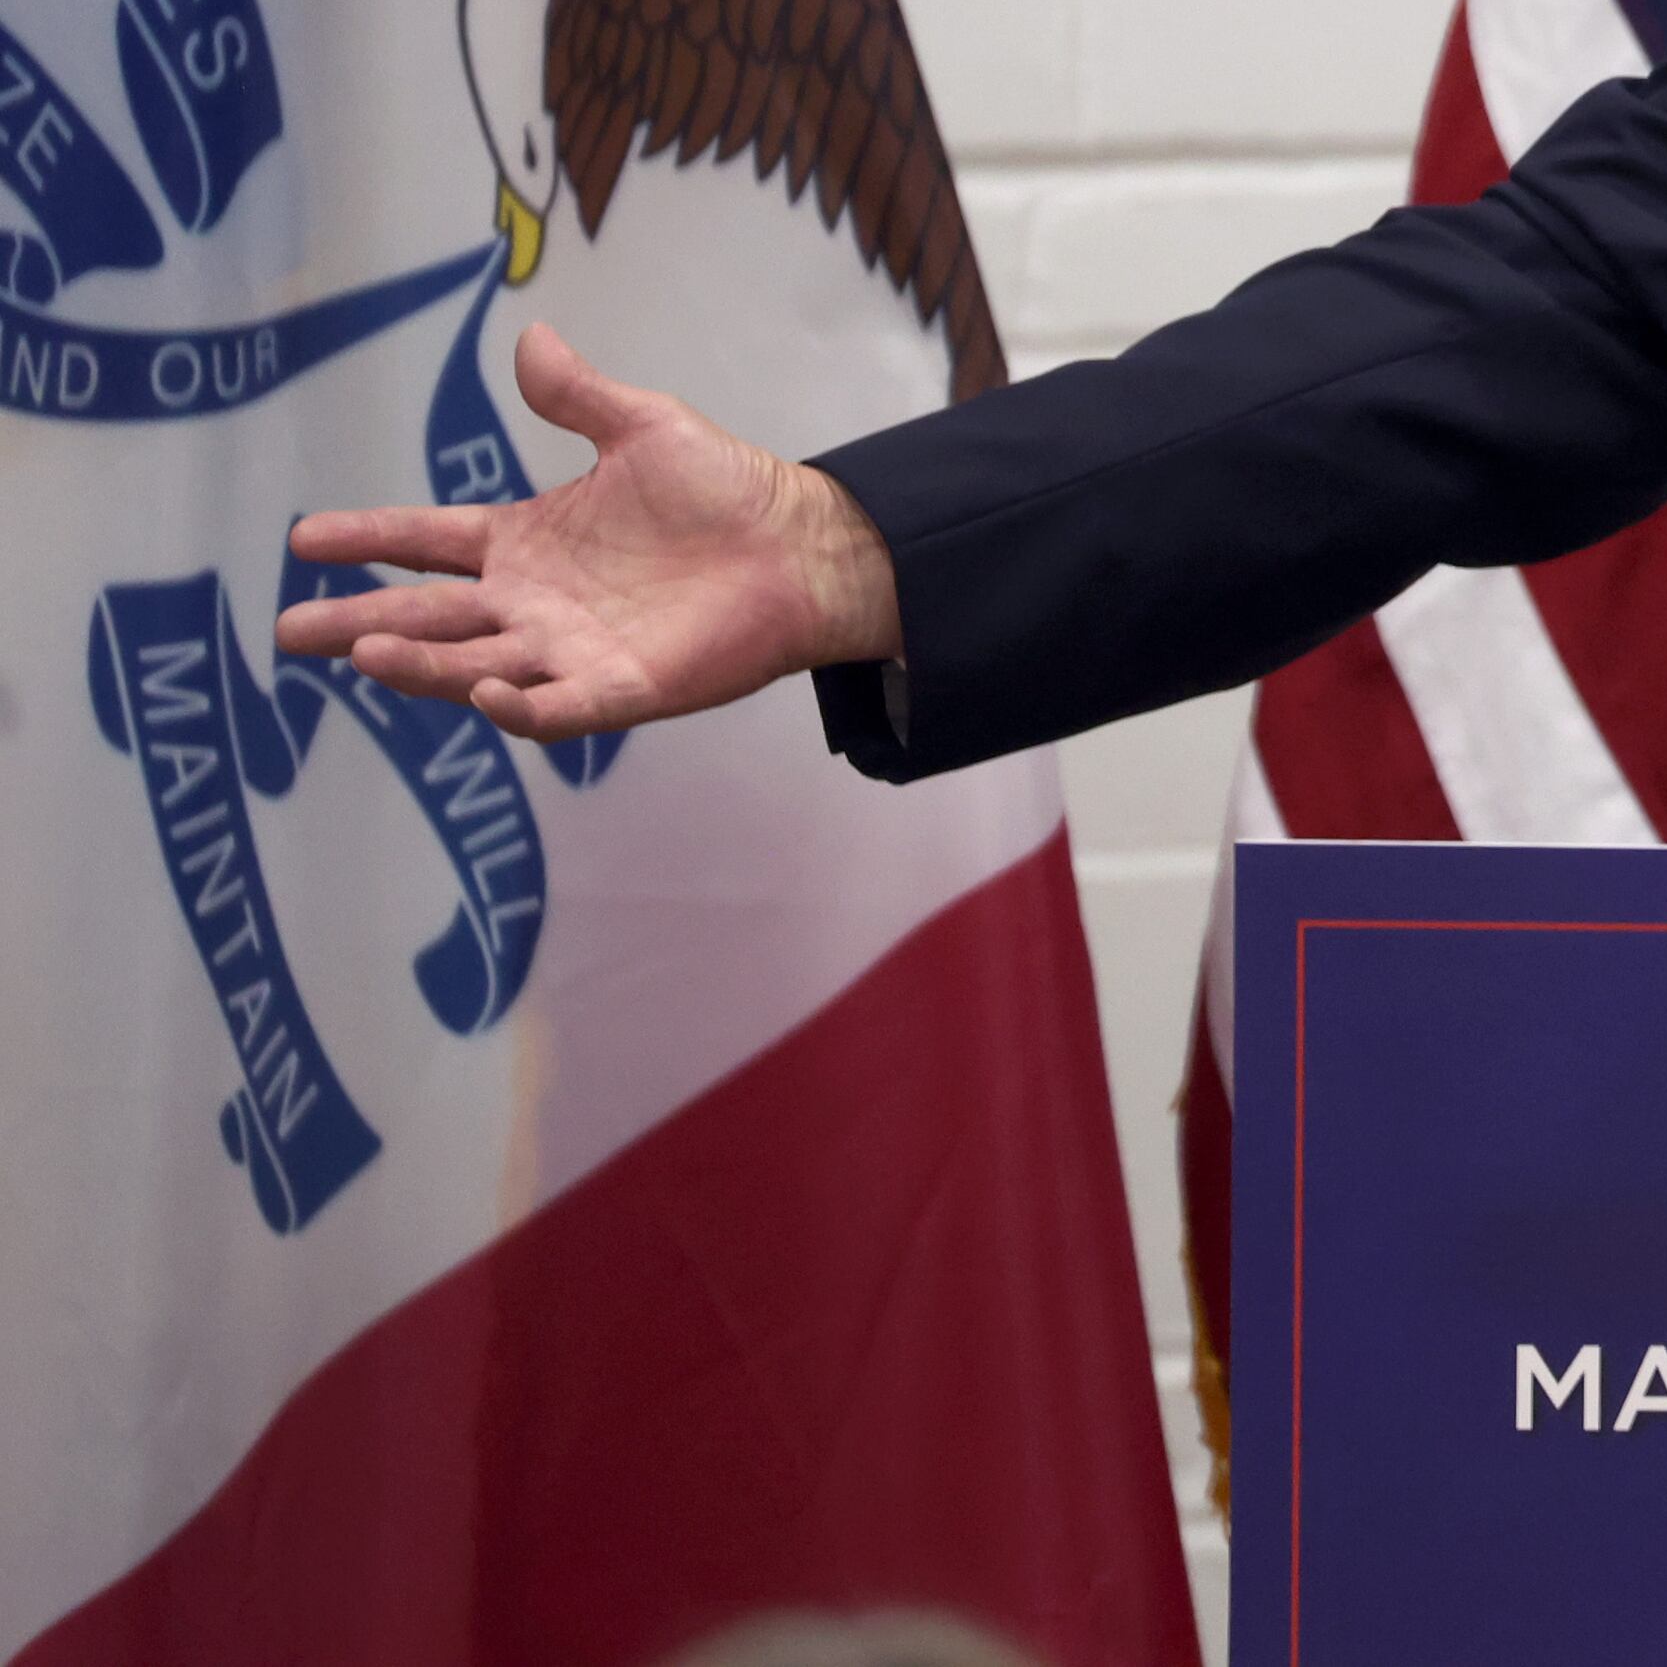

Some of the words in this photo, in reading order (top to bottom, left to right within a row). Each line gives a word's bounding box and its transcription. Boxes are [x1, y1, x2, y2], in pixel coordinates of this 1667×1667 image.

[0, 322, 100, 409] ND
[138, 637, 319, 1142] MAINTAIN
[423, 714, 541, 955] WILL
